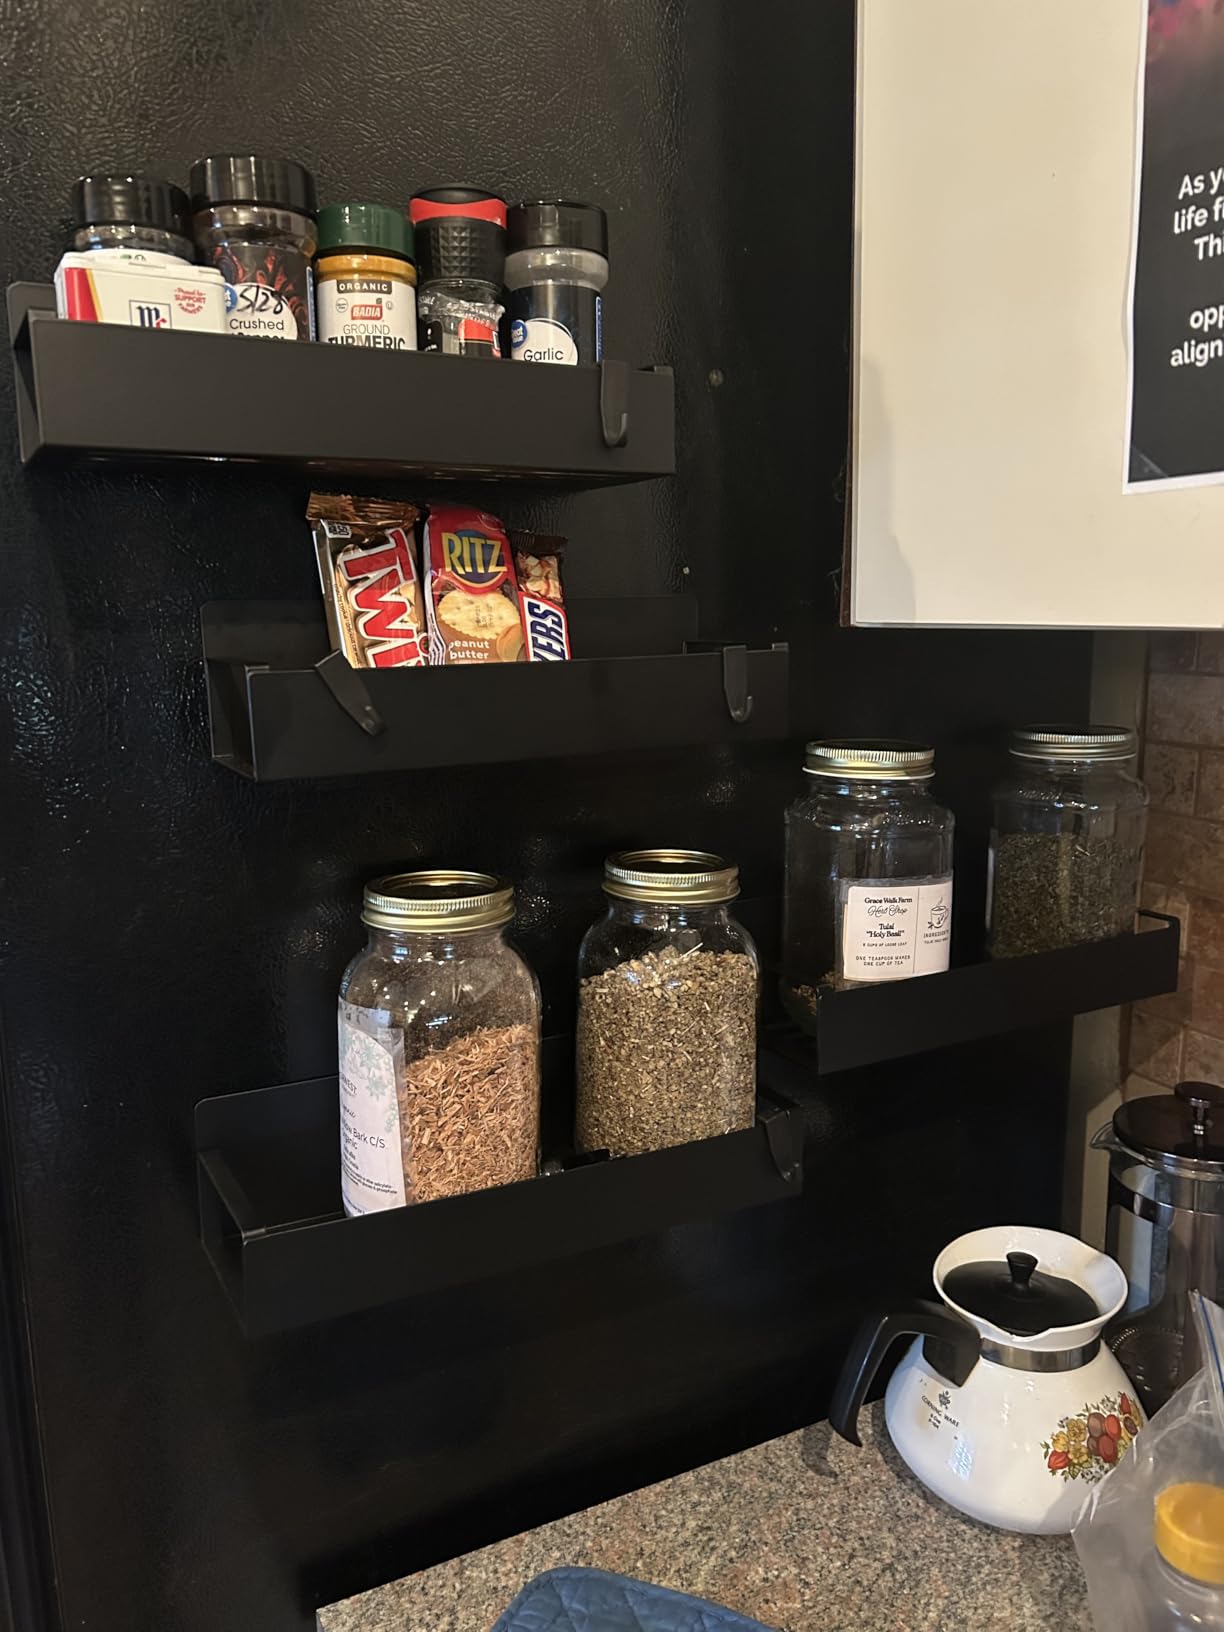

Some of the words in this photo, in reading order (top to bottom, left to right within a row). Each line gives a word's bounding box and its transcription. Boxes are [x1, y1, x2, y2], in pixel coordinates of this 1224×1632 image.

[1178, 174, 1204, 200] As
[1210, 167, 1224, 195] y
[1173, 205, 1208, 234] life
[339, 282, 388, 291] ORGANIC
[352, 306, 380, 317] BADIA
[229, 318, 285, 331] Crushed
[343, 323, 391, 336] GROUND
[523, 347, 565, 362] Garlic
[441, 532, 508, 575] RITZ
[449, 649, 490, 660] butter
[864, 896, 883, 904] Grace
[883, 896, 898, 904] Walk
[352, 1127, 368, 1145] Bark
[369, 1135, 386, 1149] C/S
